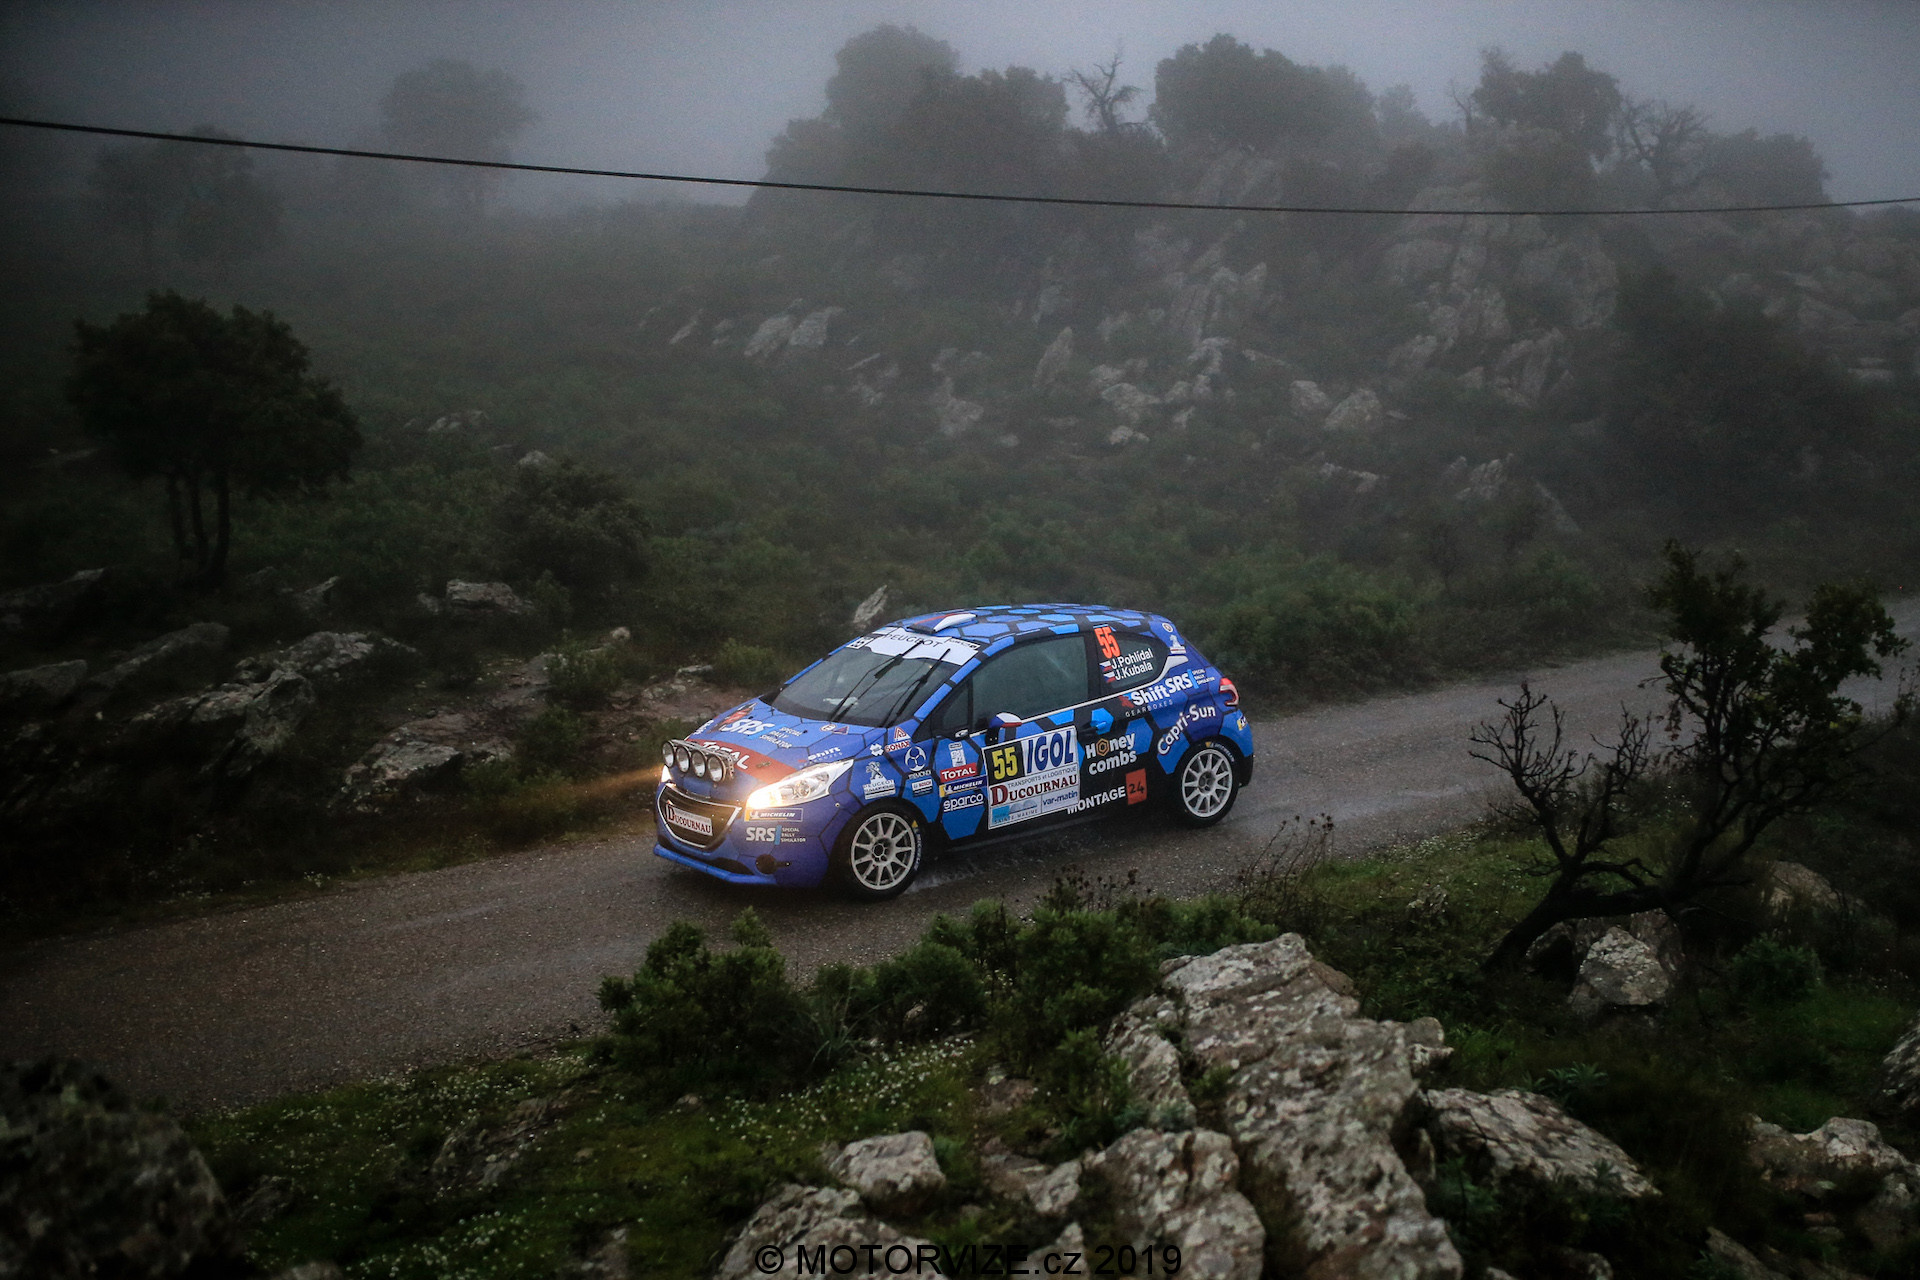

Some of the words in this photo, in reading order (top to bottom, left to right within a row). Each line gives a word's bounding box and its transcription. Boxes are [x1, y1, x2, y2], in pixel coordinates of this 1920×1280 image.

[1094, 626, 1120, 659] 55
[1114, 661, 1154, 681] J.Kubala
[1165, 673, 1194, 694] SRS
[1130, 684, 1170, 706] Shift
[1125, 699, 1174, 718] GEARBOXES
[718, 718, 775, 735] SRS
[1157, 704, 1216, 755] Capri-Sun
[884, 740, 911, 753] SONAX
[1026, 730, 1074, 774] IGOL
[992, 746, 1018, 780] 55
[1088, 750, 1137, 775] combs
[941, 768, 976, 780] TOTAL
[1008, 774, 1042, 788] TRANSPORTS
[1047, 766, 1077, 779] LOGISTIQUE
[953, 780, 983, 791] MICHELIN
[1128, 781, 1145, 794] 24
[943, 793, 984, 811] sparco
[746, 827, 776, 842] SRS
